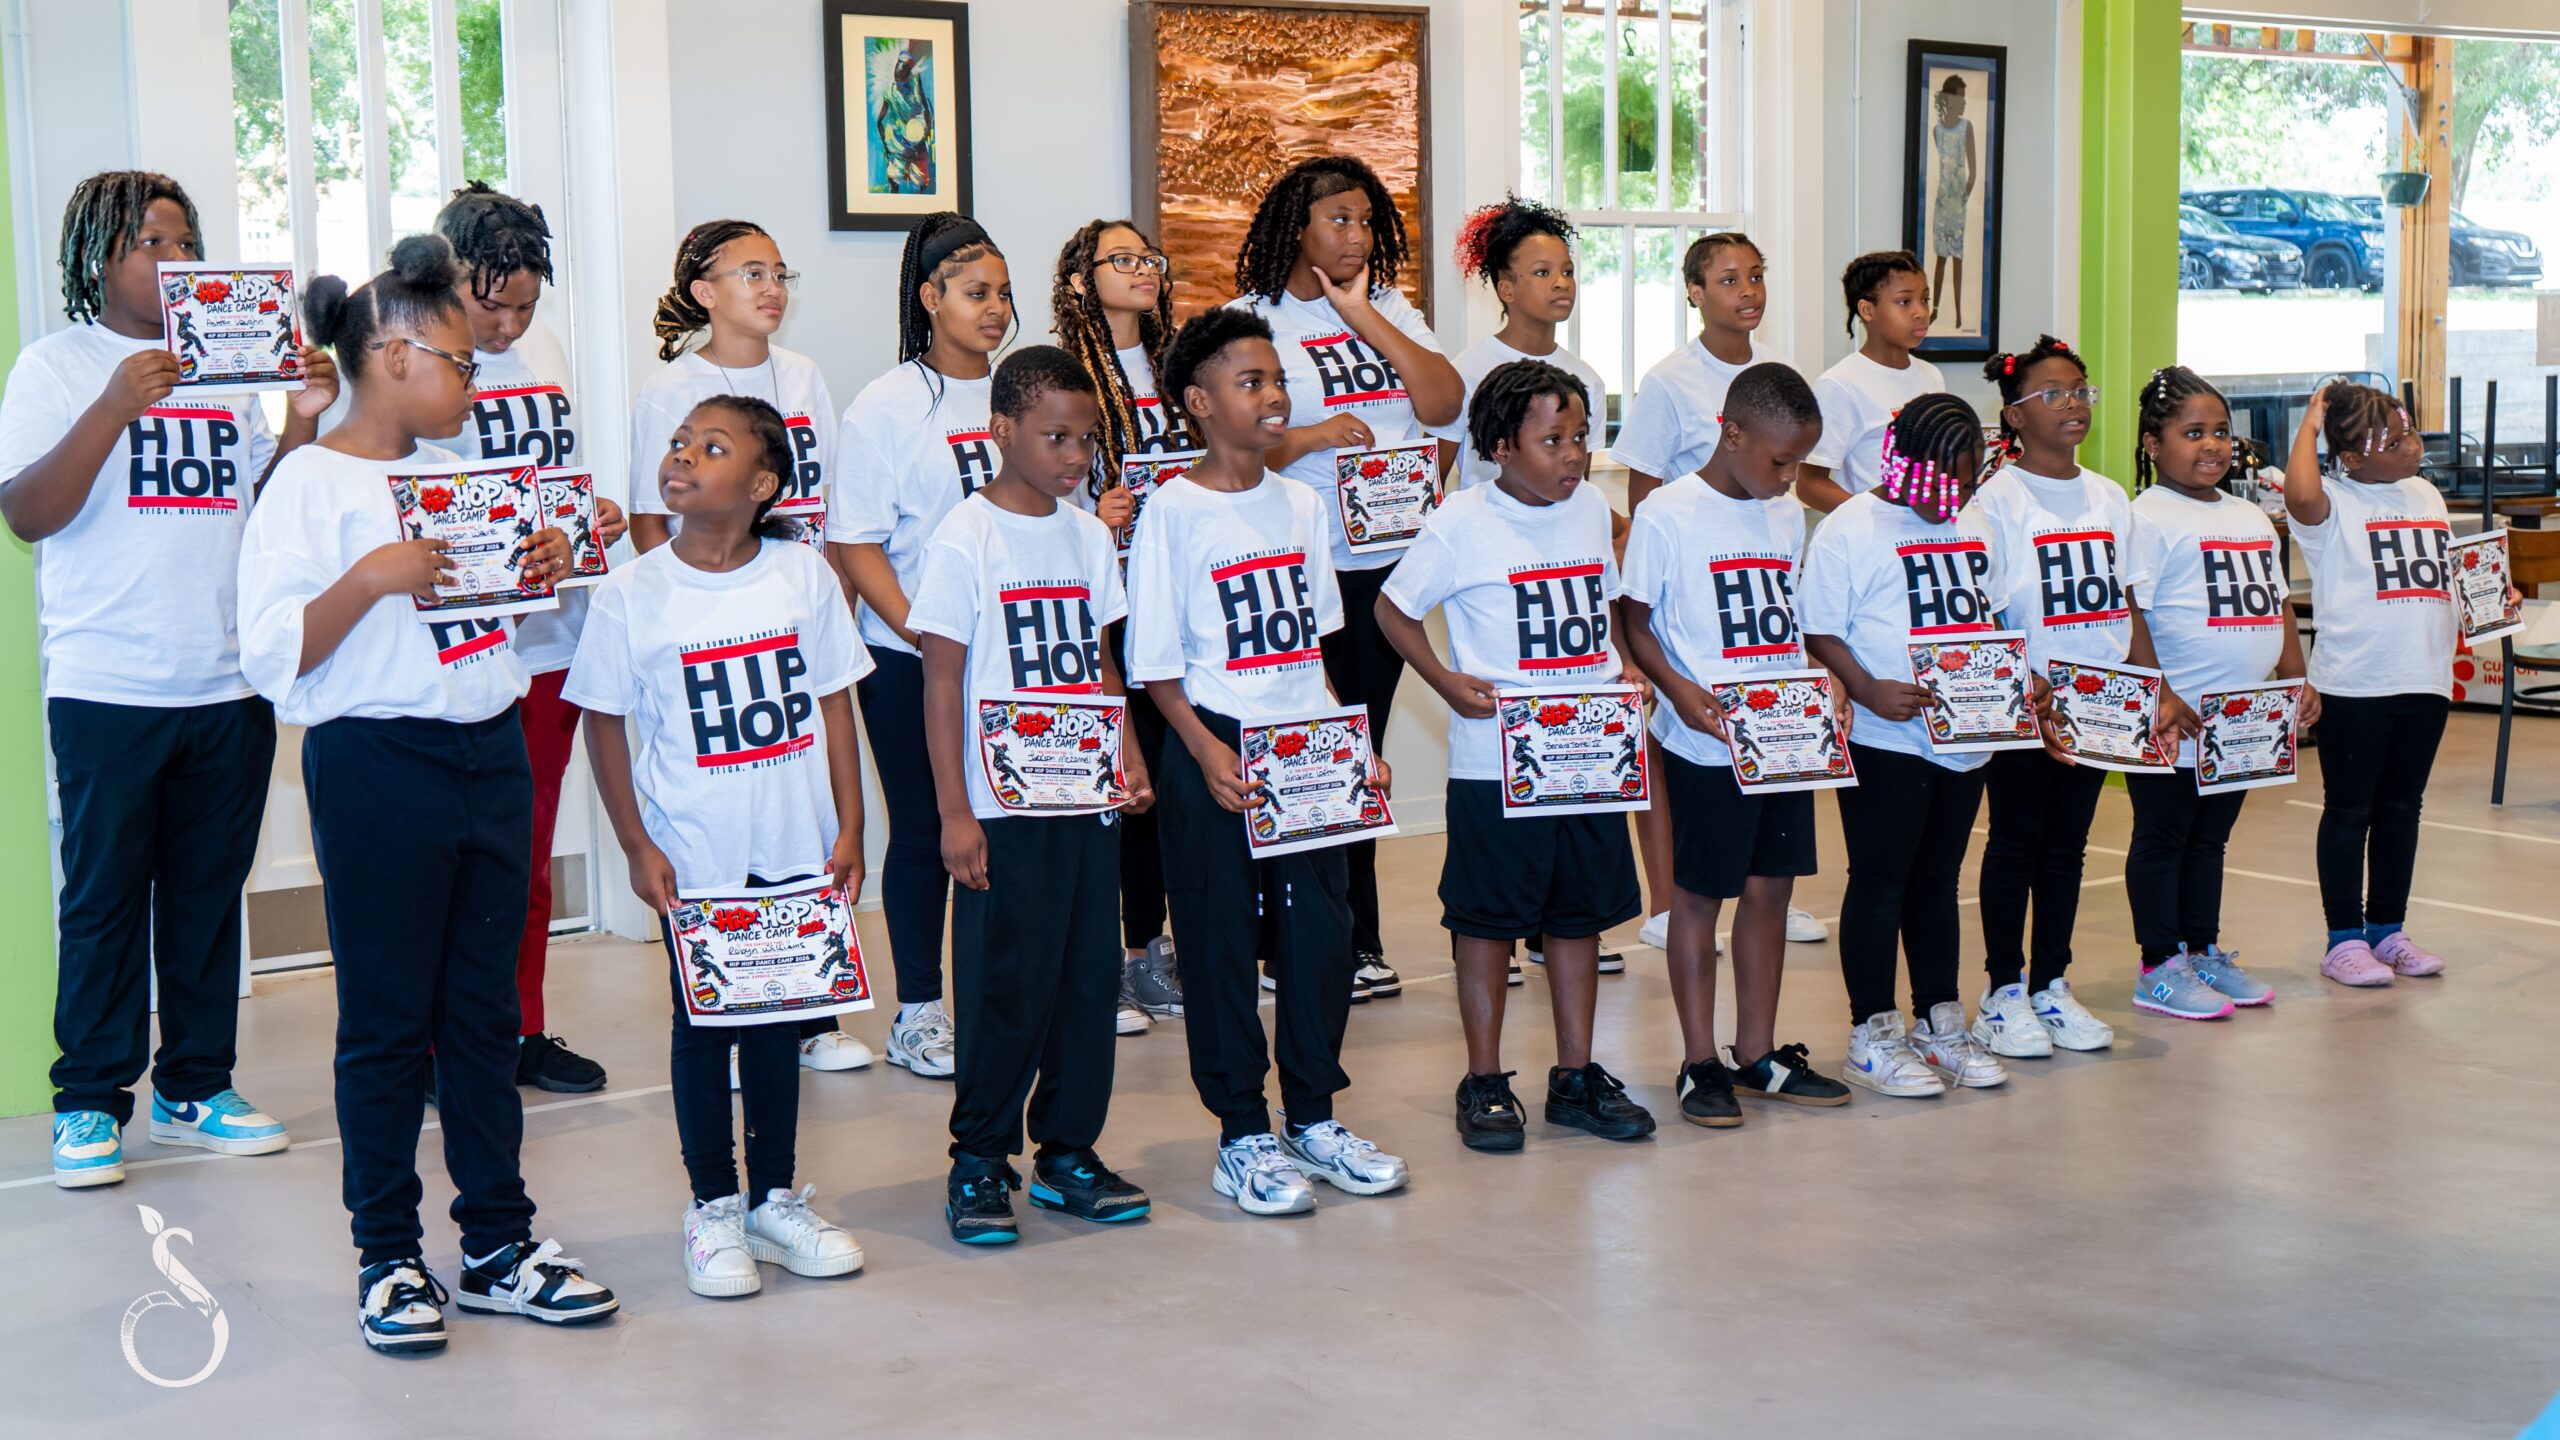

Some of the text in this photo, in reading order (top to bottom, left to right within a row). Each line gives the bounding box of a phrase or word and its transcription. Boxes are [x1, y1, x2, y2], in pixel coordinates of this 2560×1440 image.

[230, 278, 269, 302] HOP
[207, 304, 233, 313] DANCE
[236, 303, 257, 312] CAMP
[1305, 338, 1388, 367] HI
[473, 393, 571, 436] HIP
[128, 417, 239, 457] HIP
[130, 457, 236, 497] HOP
[1388, 453, 1417, 475] HOP
[452, 478, 502, 511] HOP
[540, 484, 566, 506] OP
[1369, 477, 1389, 487] DANCE
[1391, 475, 1407, 484] CAMP
[179, 508, 232, 516] MISSISSIPPI
[433, 512, 457, 525] DANCE
[461, 509, 486, 522] CAMP
[2369, 529, 2450, 561] HIP
[1901, 551, 1989, 591] HIP
[2037, 540, 2115, 581] HIP
[2203, 550, 2272, 583] HIP
[2374, 558, 2450, 591] HOP
[1216, 565, 1309, 622] HIP
[1513, 575, 1603, 619] HIP
[1713, 568, 1793, 610] HIP
[2041, 575, 2124, 617] HOP
[2207, 583, 2281, 617] HOP
[1908, 587, 1991, 628] HOP
[1003, 599, 1096, 646] HIP
[1226, 607, 1317, 660] HOP
[1517, 614, 1607, 659] HOP
[1719, 606, 1799, 648] HOP
[679, 643, 701, 653] 2026
[707, 636, 744, 648] SUMMER
[750, 629, 779, 641] DANCE
[1009, 641, 1102, 689] HOP
[1238, 667, 1271, 676] UTICA,
[1970, 645, 2003, 670] HOP
[683, 647, 807, 710] HIP
[1949, 671, 1971, 680] DANCE
[1974, 670, 1992, 679] CAMP
[2104, 678, 2136, 700] HOP
[1778, 684, 1811, 708] HOP
[2251, 693, 2280, 714] HOP
[690, 691, 812, 755] HOP
[1051, 711, 1094, 737] HOP
[1576, 699, 1616, 725] HOP
[1758, 710, 1781, 720] DANCE
[1784, 708, 1802, 717] CAMP
[1024, 738, 1052, 748] DANCE
[1055, 739, 1077, 748] CAMP
[1306, 725, 1343, 754] HOP
[1547, 725, 1575, 737] DANCE
[1580, 725, 1602, 734] CAMP
[710, 765, 745, 775] UTICA,
[1283, 757, 1308, 769] DANCE
[1311, 754, 1331, 764] CAMP
[756, 900, 812, 929] HOP
[727, 919, 827, 942] DANCE CAMP 2026
[2152, 982, 2172, 1001] N
